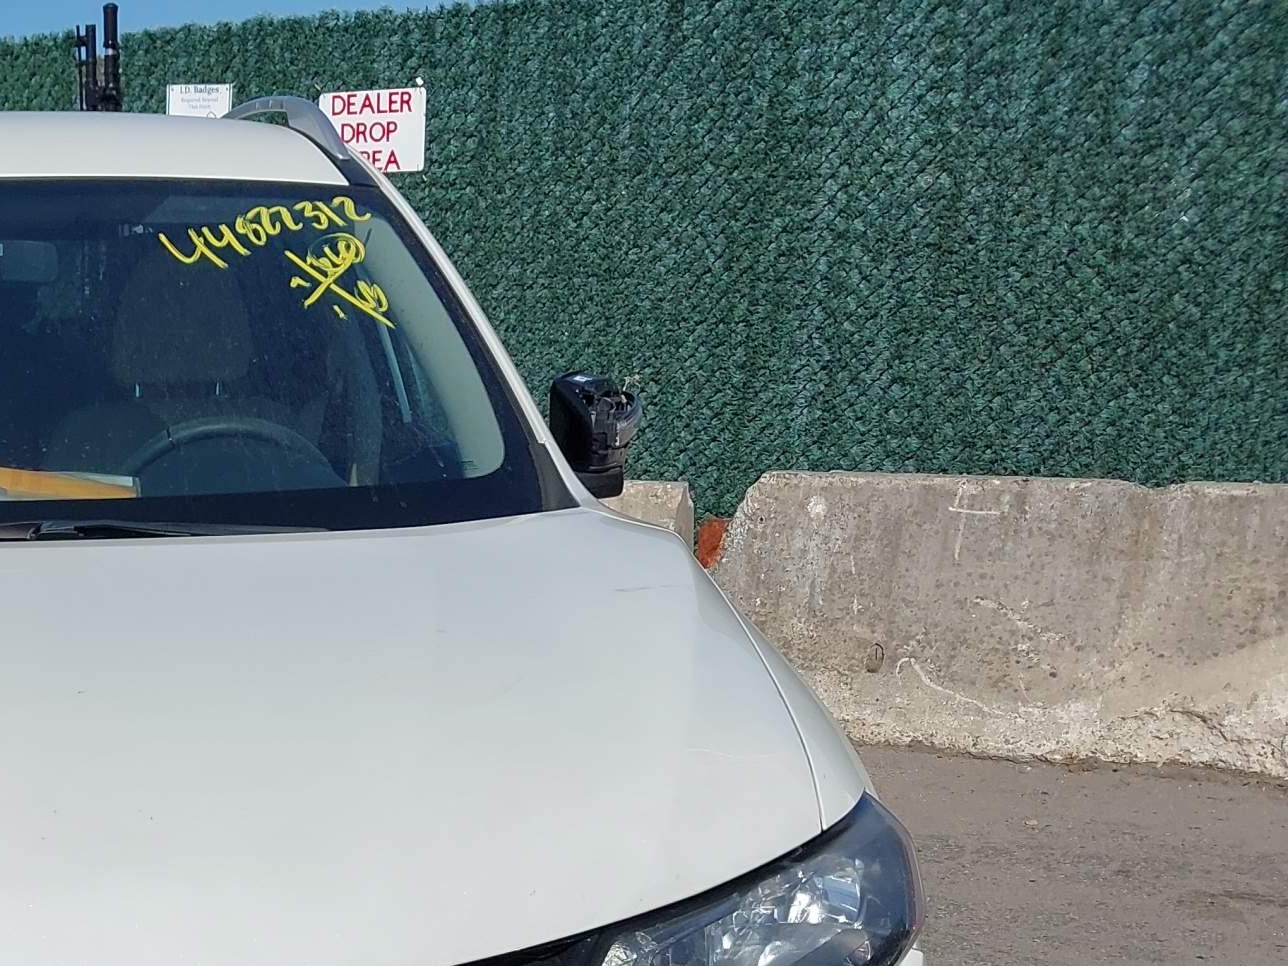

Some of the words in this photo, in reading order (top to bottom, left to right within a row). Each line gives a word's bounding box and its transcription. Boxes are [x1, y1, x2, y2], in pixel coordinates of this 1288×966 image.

[194, 85, 220, 96] Badges
[332, 91, 412, 116] DEALER
[341, 121, 398, 144] DROP
